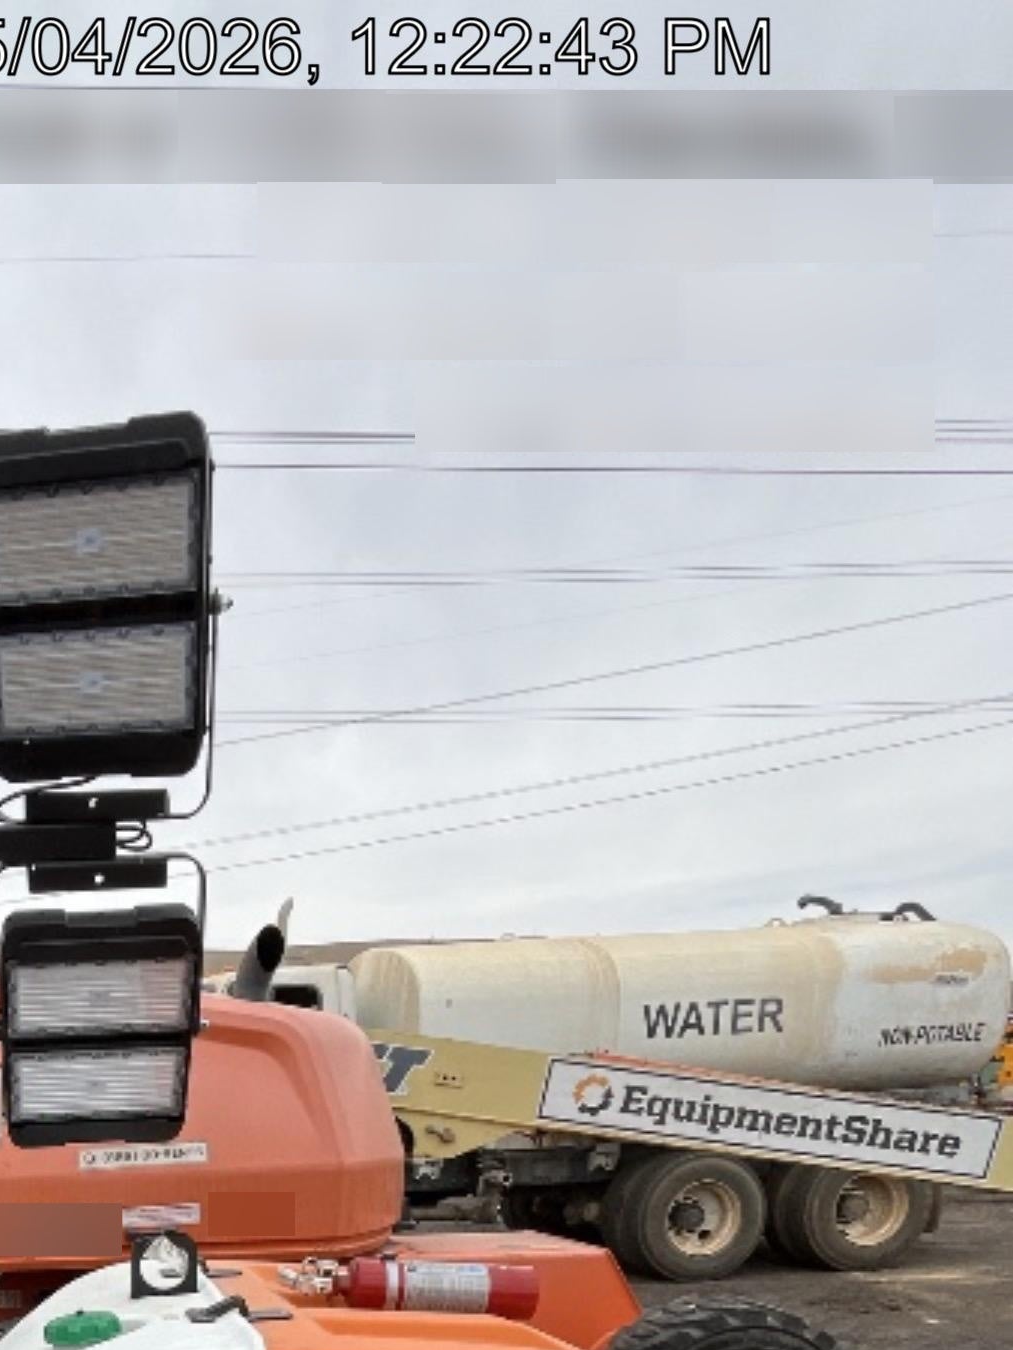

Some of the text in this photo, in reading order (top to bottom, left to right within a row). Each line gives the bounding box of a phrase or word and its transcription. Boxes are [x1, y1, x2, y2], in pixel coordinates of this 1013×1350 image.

[643, 998, 784, 1039] WATER
[878, 1022, 986, 1047] NON-POTABLE
[620, 1084, 962, 1159] EquipmentShare
